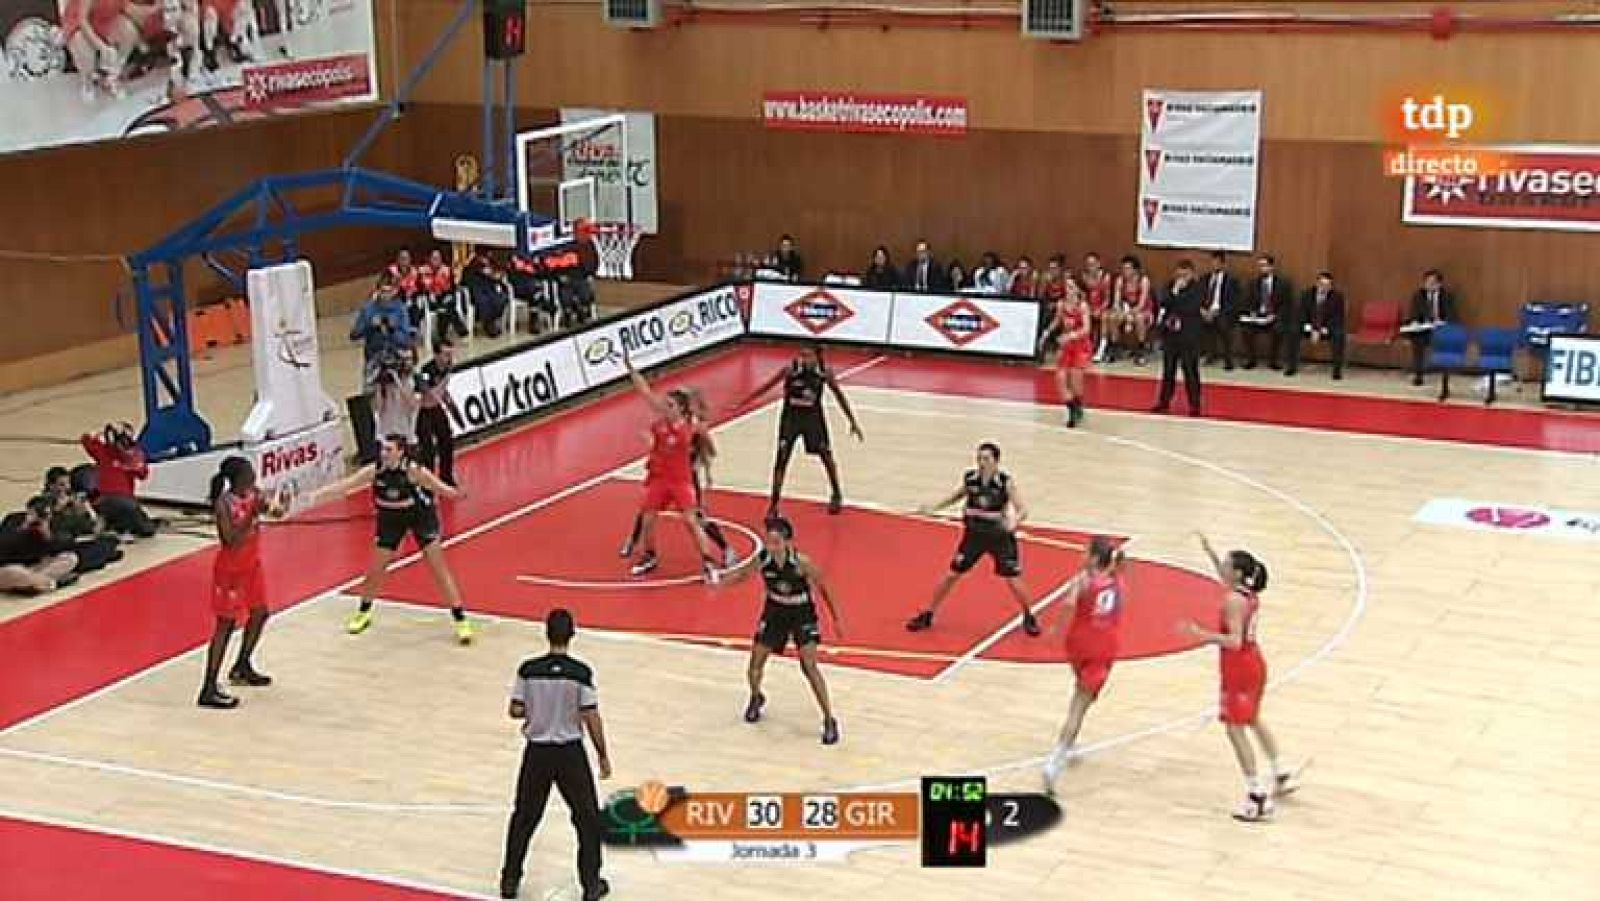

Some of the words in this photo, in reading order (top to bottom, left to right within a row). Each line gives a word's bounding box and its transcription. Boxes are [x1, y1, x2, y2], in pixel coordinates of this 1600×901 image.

[698, 291, 738, 326] RICO
[618, 316, 665, 352] RICO
[1551, 349, 1600, 387] FIB
[261, 441, 318, 478] Rivas
